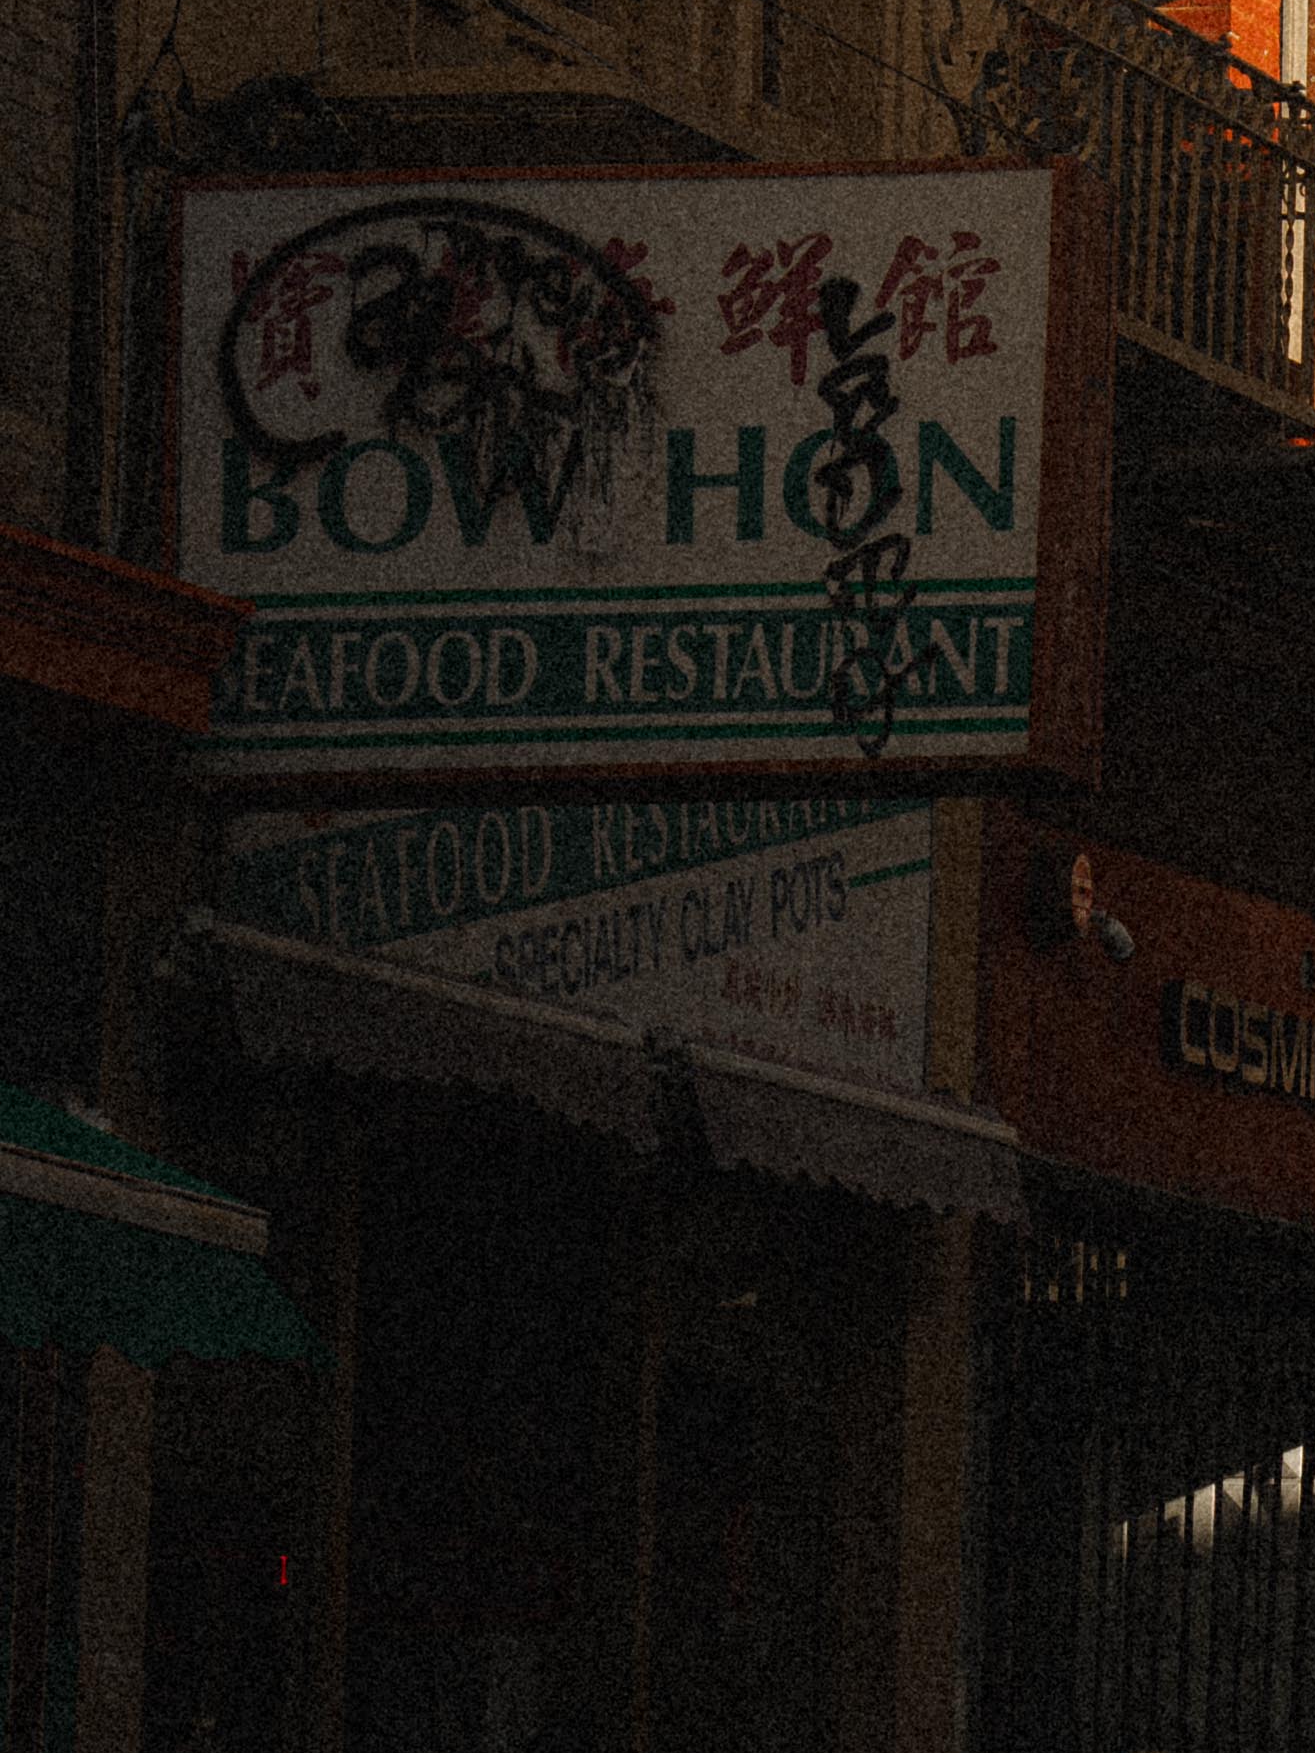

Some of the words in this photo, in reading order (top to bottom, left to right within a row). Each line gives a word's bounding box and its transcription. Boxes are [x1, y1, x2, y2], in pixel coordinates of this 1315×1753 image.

[222, 431, 582, 553] BOW
[665, 416, 1015, 544] HON
[584, 614, 1025, 707] RESTAURANT
[297, 803, 554, 939] SEAFOOD
[681, 875, 757, 962] CLAY
[770, 850, 847, 939] POTS
